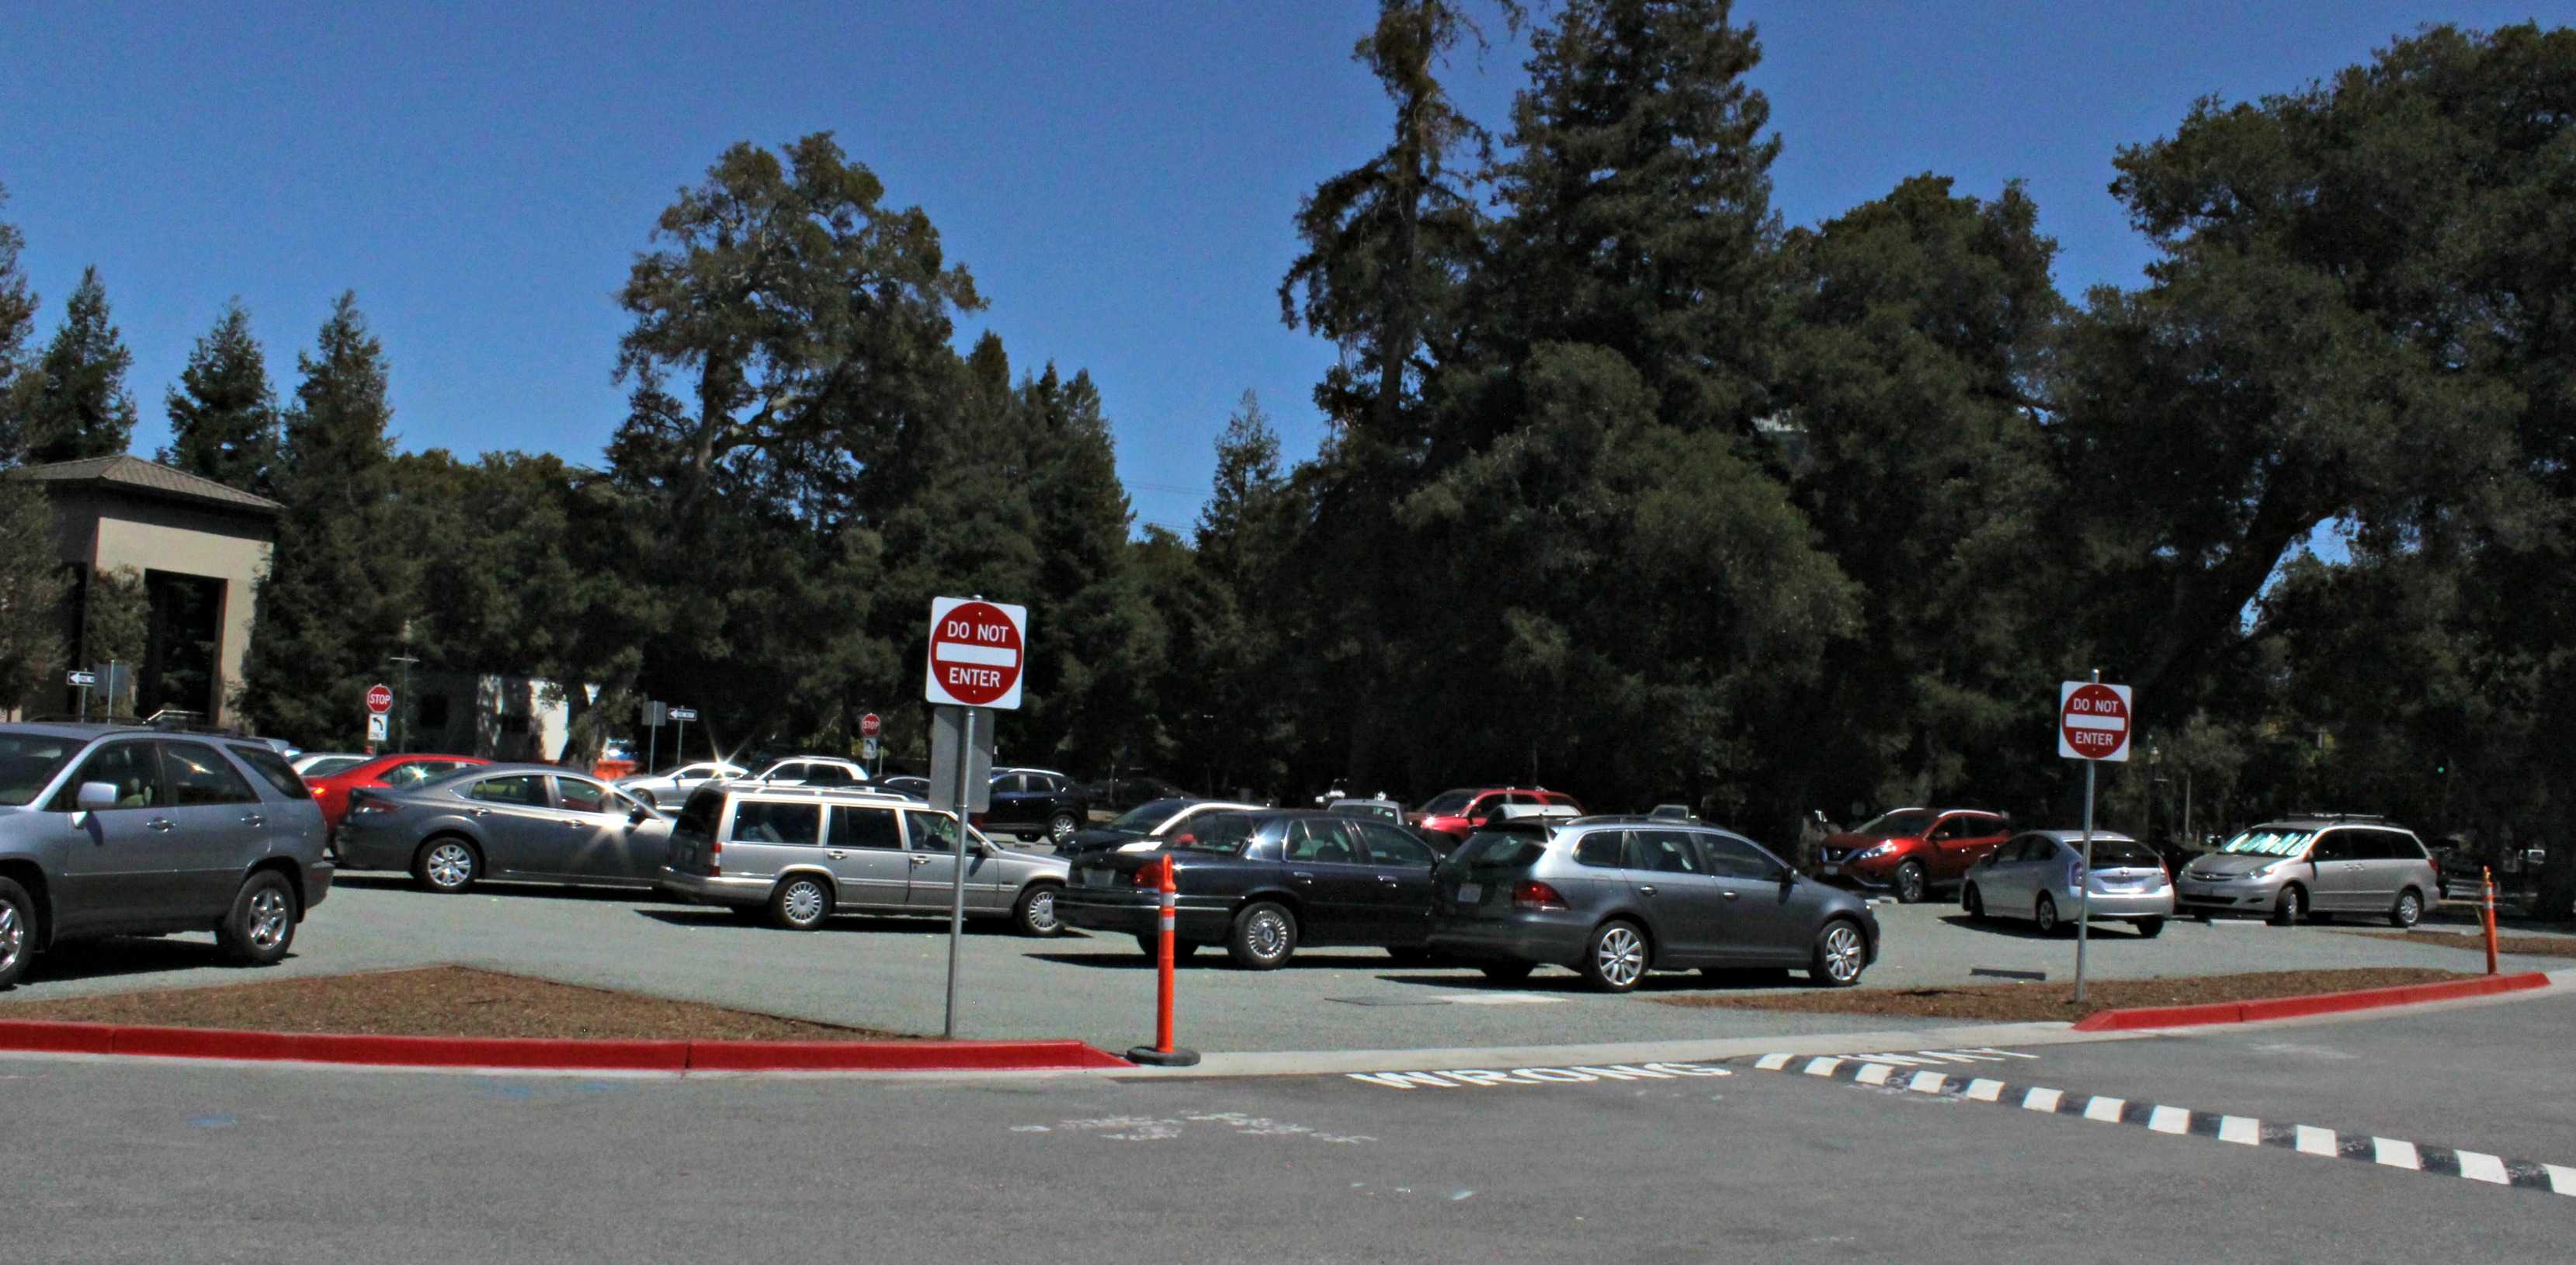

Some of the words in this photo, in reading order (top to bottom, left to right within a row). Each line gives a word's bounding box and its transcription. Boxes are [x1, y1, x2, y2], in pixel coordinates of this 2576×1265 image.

[947, 621, 970, 639] DO
[977, 624, 1009, 643] NOT
[949, 667, 1001, 688] ENTER
[369, 693, 391, 705] STOP
[2073, 698, 2090, 712] DO
[2095, 700, 2119, 713] NOT
[863, 721, 880, 730] STOP
[2074, 731, 2113, 747] ENTER
[1345, 1062, 1733, 1088] WRONG
